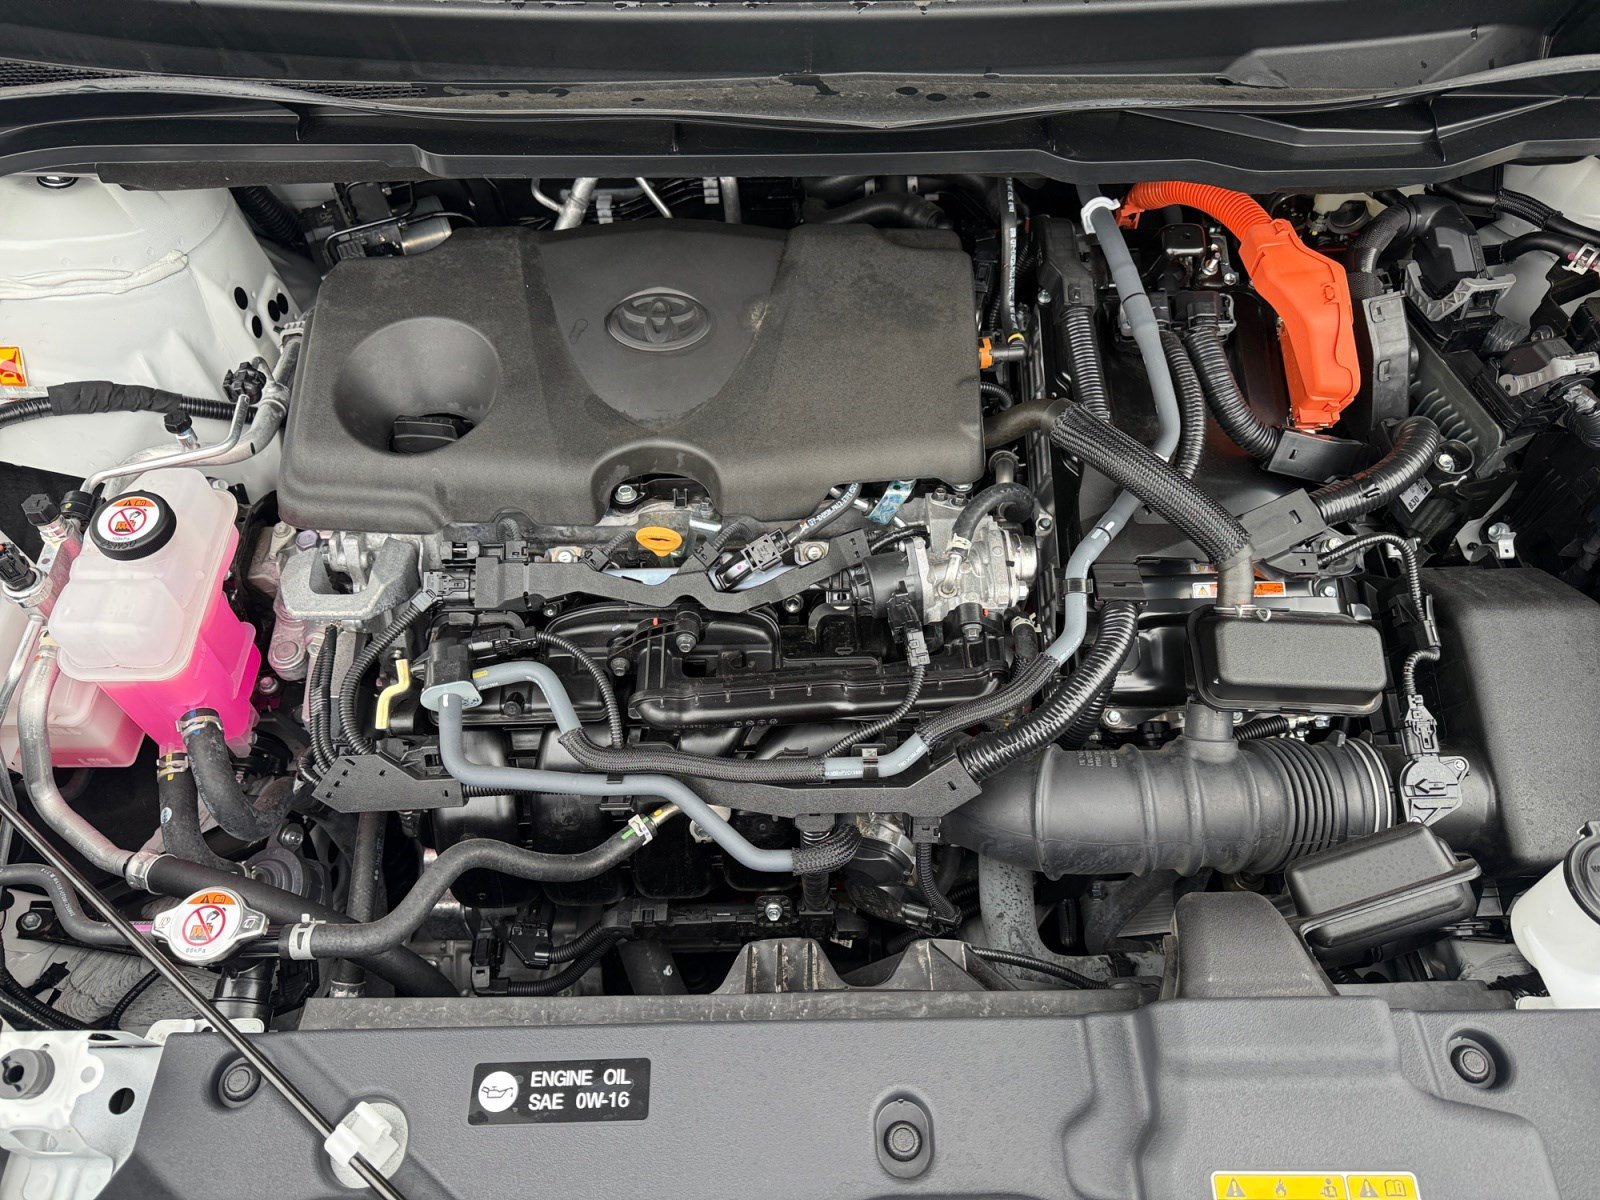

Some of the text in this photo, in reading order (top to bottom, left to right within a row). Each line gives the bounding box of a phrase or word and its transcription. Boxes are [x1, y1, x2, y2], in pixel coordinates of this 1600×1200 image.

[530, 1068, 632, 1087] ENGINE OIL
[528, 1091, 630, 1111] SAE 0W-16
